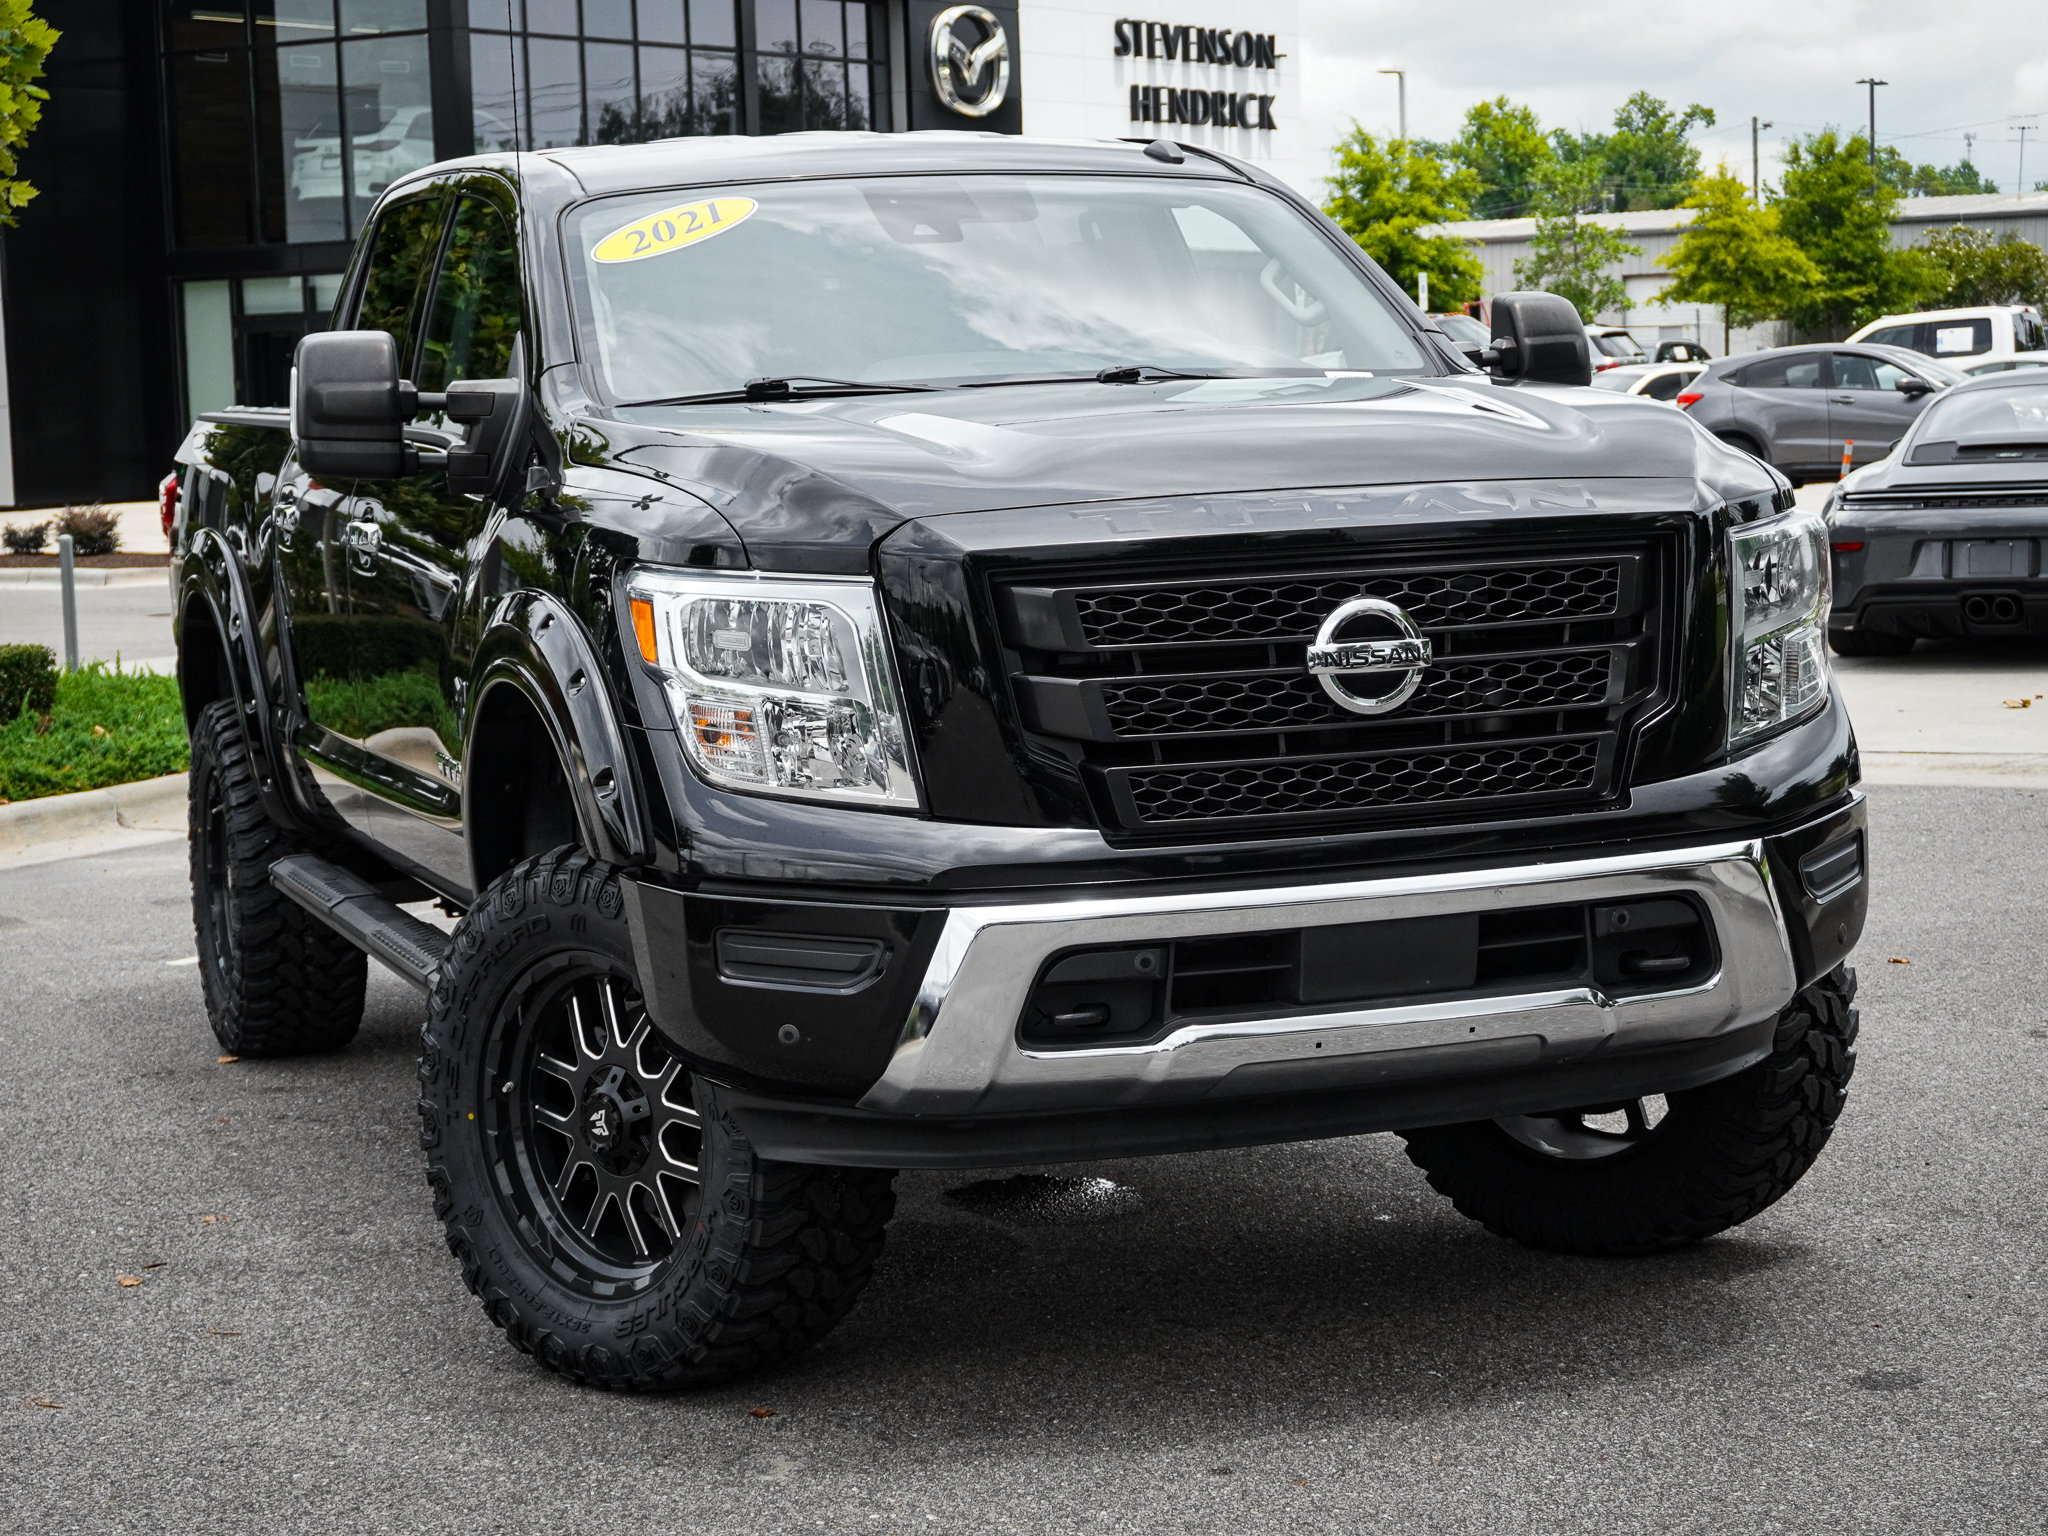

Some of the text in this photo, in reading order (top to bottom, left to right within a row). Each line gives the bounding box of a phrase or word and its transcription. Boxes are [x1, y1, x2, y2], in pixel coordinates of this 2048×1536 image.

[1130, 84, 1278, 130] HENDRICK
[625, 202, 723, 254] 2021
[1069, 483, 1598, 535] TITAN
[1324, 647, 1421, 668] NISSAN
